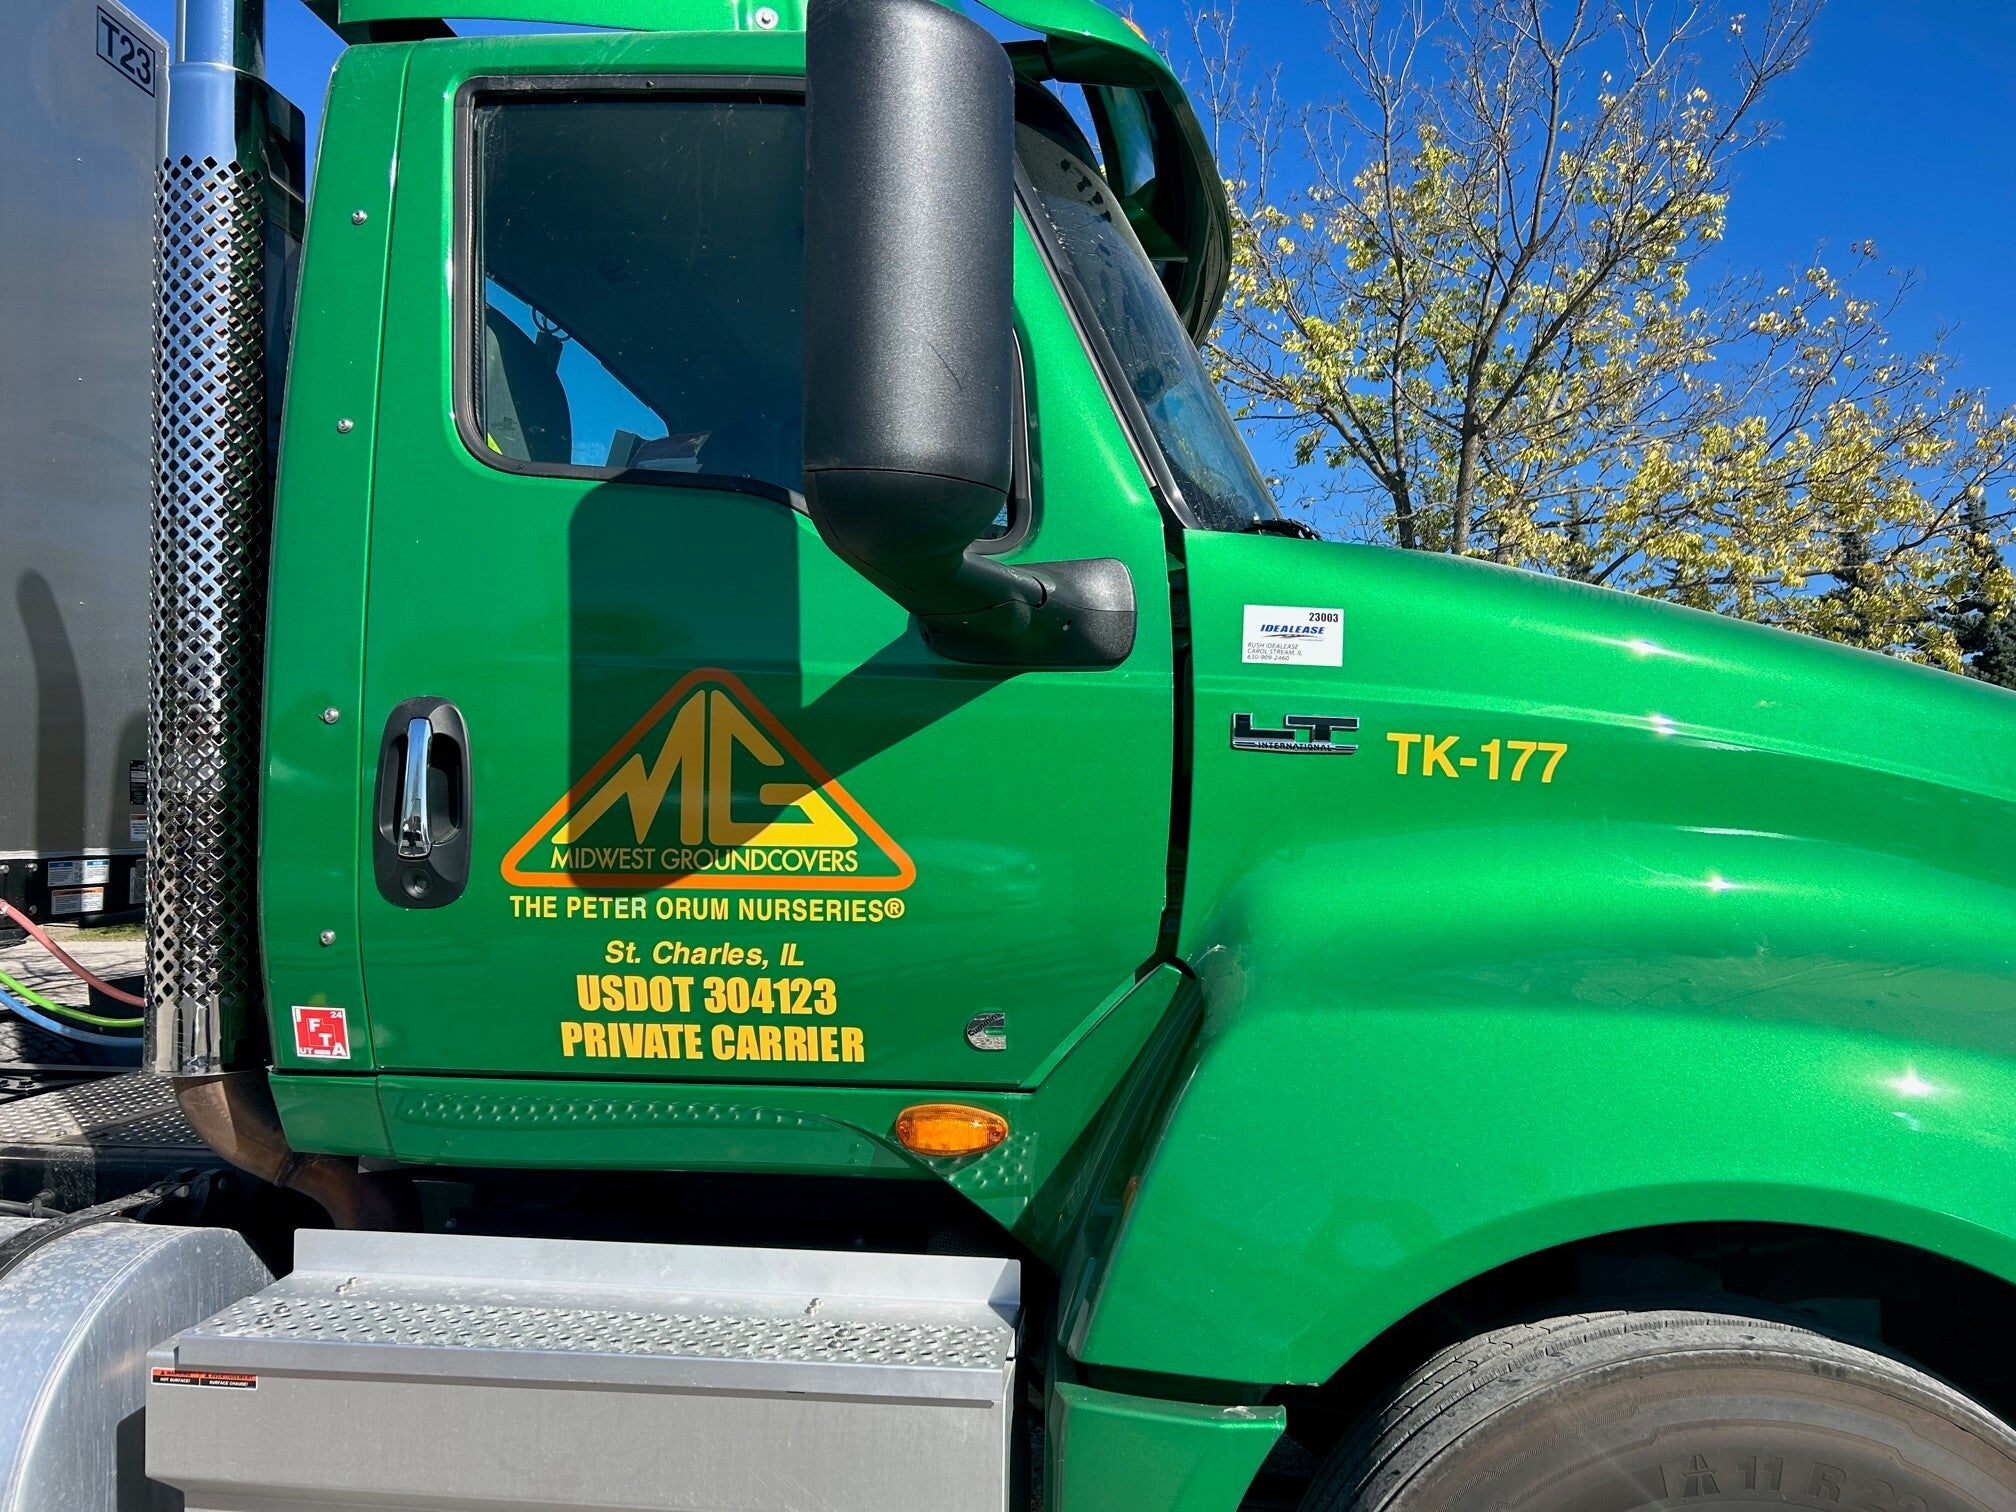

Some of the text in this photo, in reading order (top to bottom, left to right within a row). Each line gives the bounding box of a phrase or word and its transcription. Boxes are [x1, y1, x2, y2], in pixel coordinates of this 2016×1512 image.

[100, 15, 151, 85] T23
[1260, 624, 1326, 634] IDEALEASE
[1308, 612, 1339, 623] 23003
[1232, 712, 1360, 742] LT
[1256, 741, 1333, 752] INTERNATIONAL
[1386, 732, 1568, 784] TK-177
[550, 846, 858, 872] MIDWEST GROUNDCOVERS
[510, 895, 557, 918] THE
[567, 896, 647, 919] PETER
[656, 896, 729, 920] ORUM
[604, 940, 805, 970] St. Charles, IL
[576, 973, 838, 1015] USDOT 304123
[329, 1011, 343, 1019] 24
[560, 1021, 865, 1063] PRIVATE CARRIER
